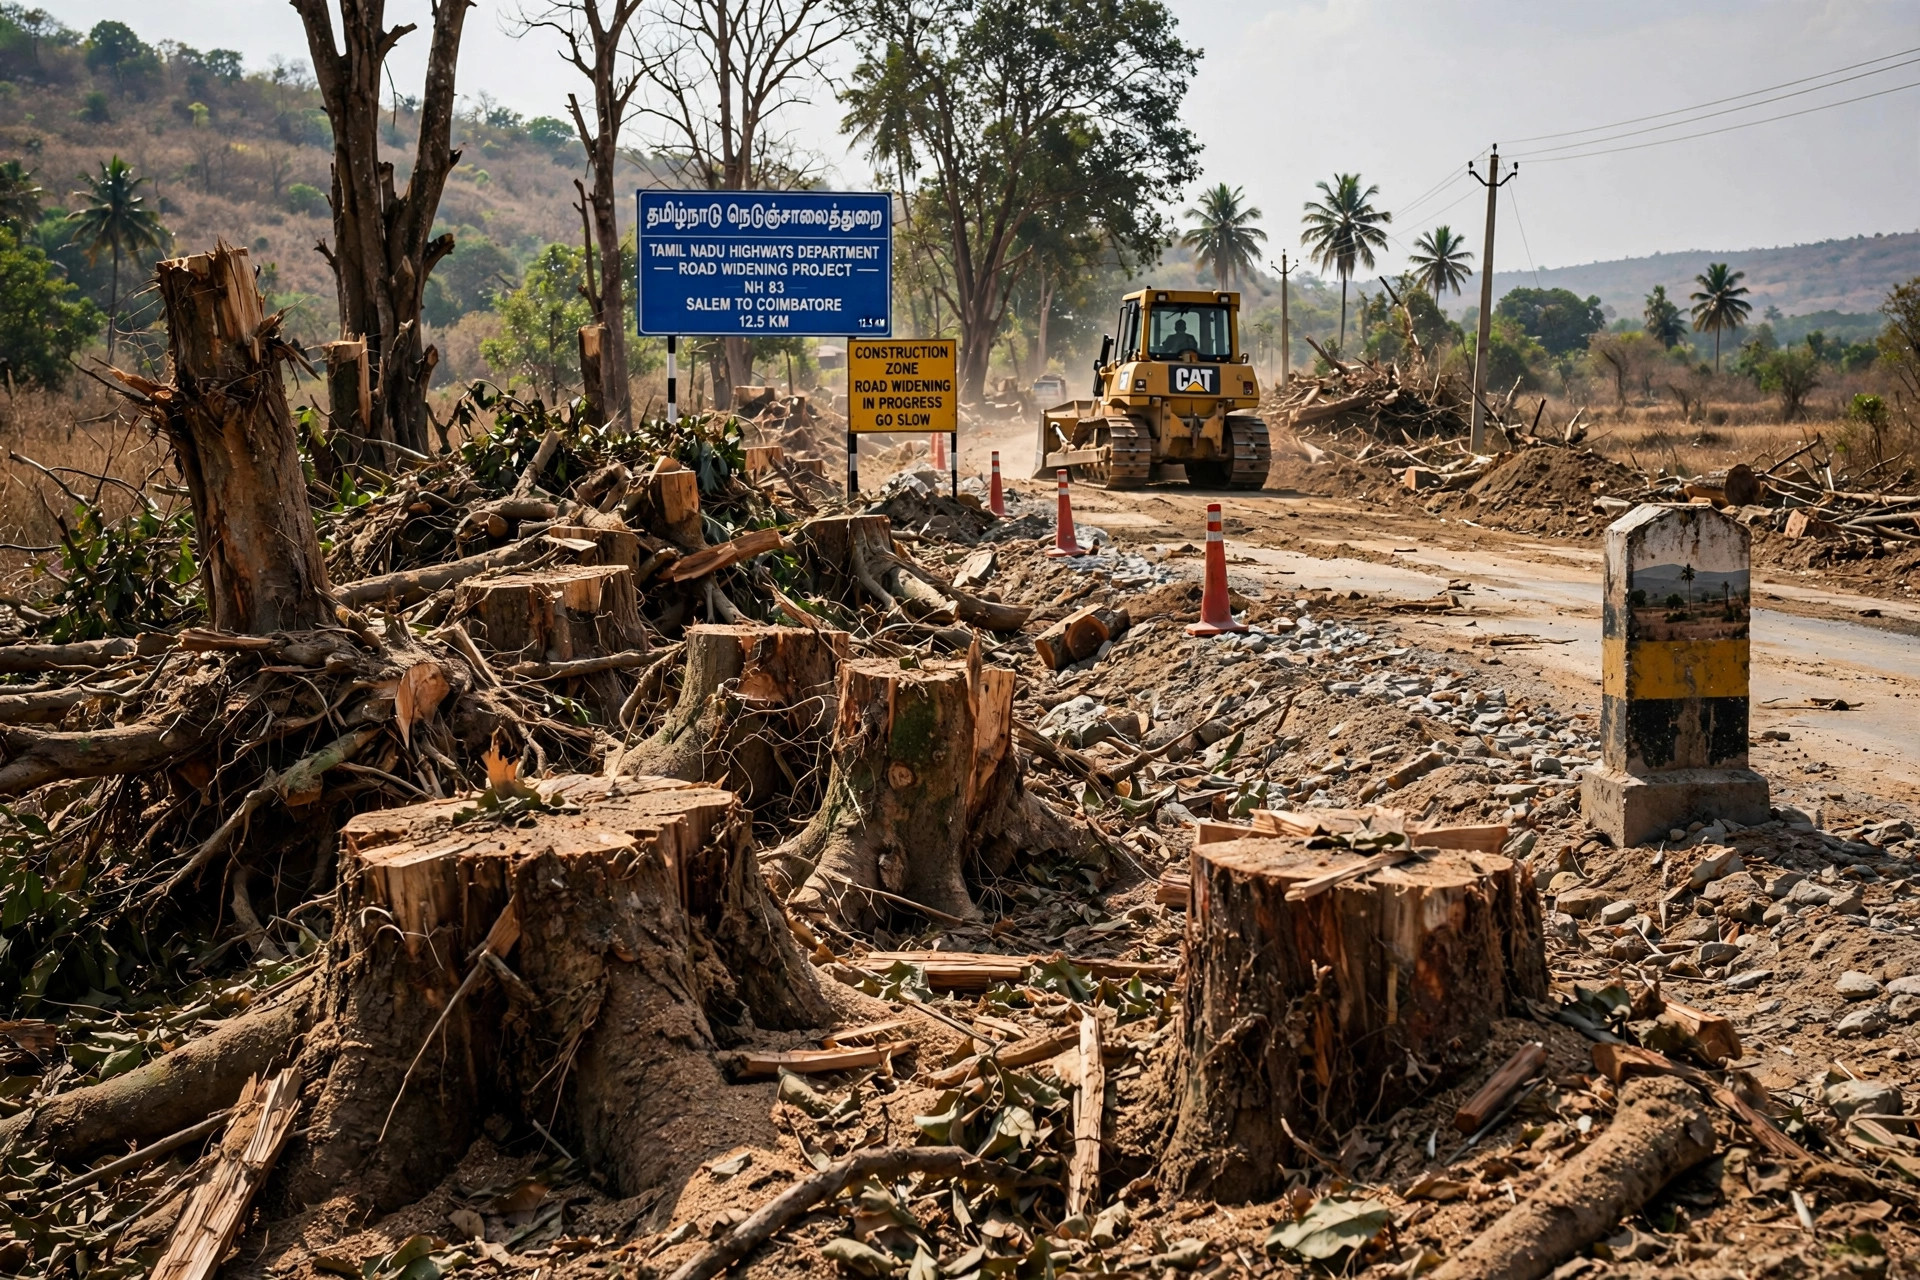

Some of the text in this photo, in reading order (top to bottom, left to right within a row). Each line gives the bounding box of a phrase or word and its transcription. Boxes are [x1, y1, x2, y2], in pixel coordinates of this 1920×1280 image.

[647, 201, 722, 230] தமிழ்நாடு
[650, 244, 879, 259] TAMIL NADU HIGHWAYS DEPARTMENT
[679, 262, 852, 276] ROAD WIDENING PROJECT
[744, 281, 784, 293] NH 83
[686, 297, 842, 311] SALEM TO COIMBATORE
[739, 315, 789, 327] 12.5 KM
[855, 346, 948, 359] CONSTRUCTION
[885, 362, 919, 375] ZONE
[855, 380, 950, 392] ROAD WIDENING
[1176, 367, 1213, 393] CAT
[863, 397, 942, 409] IN PROGRESS
[876, 414, 930, 426] GO SLOW
